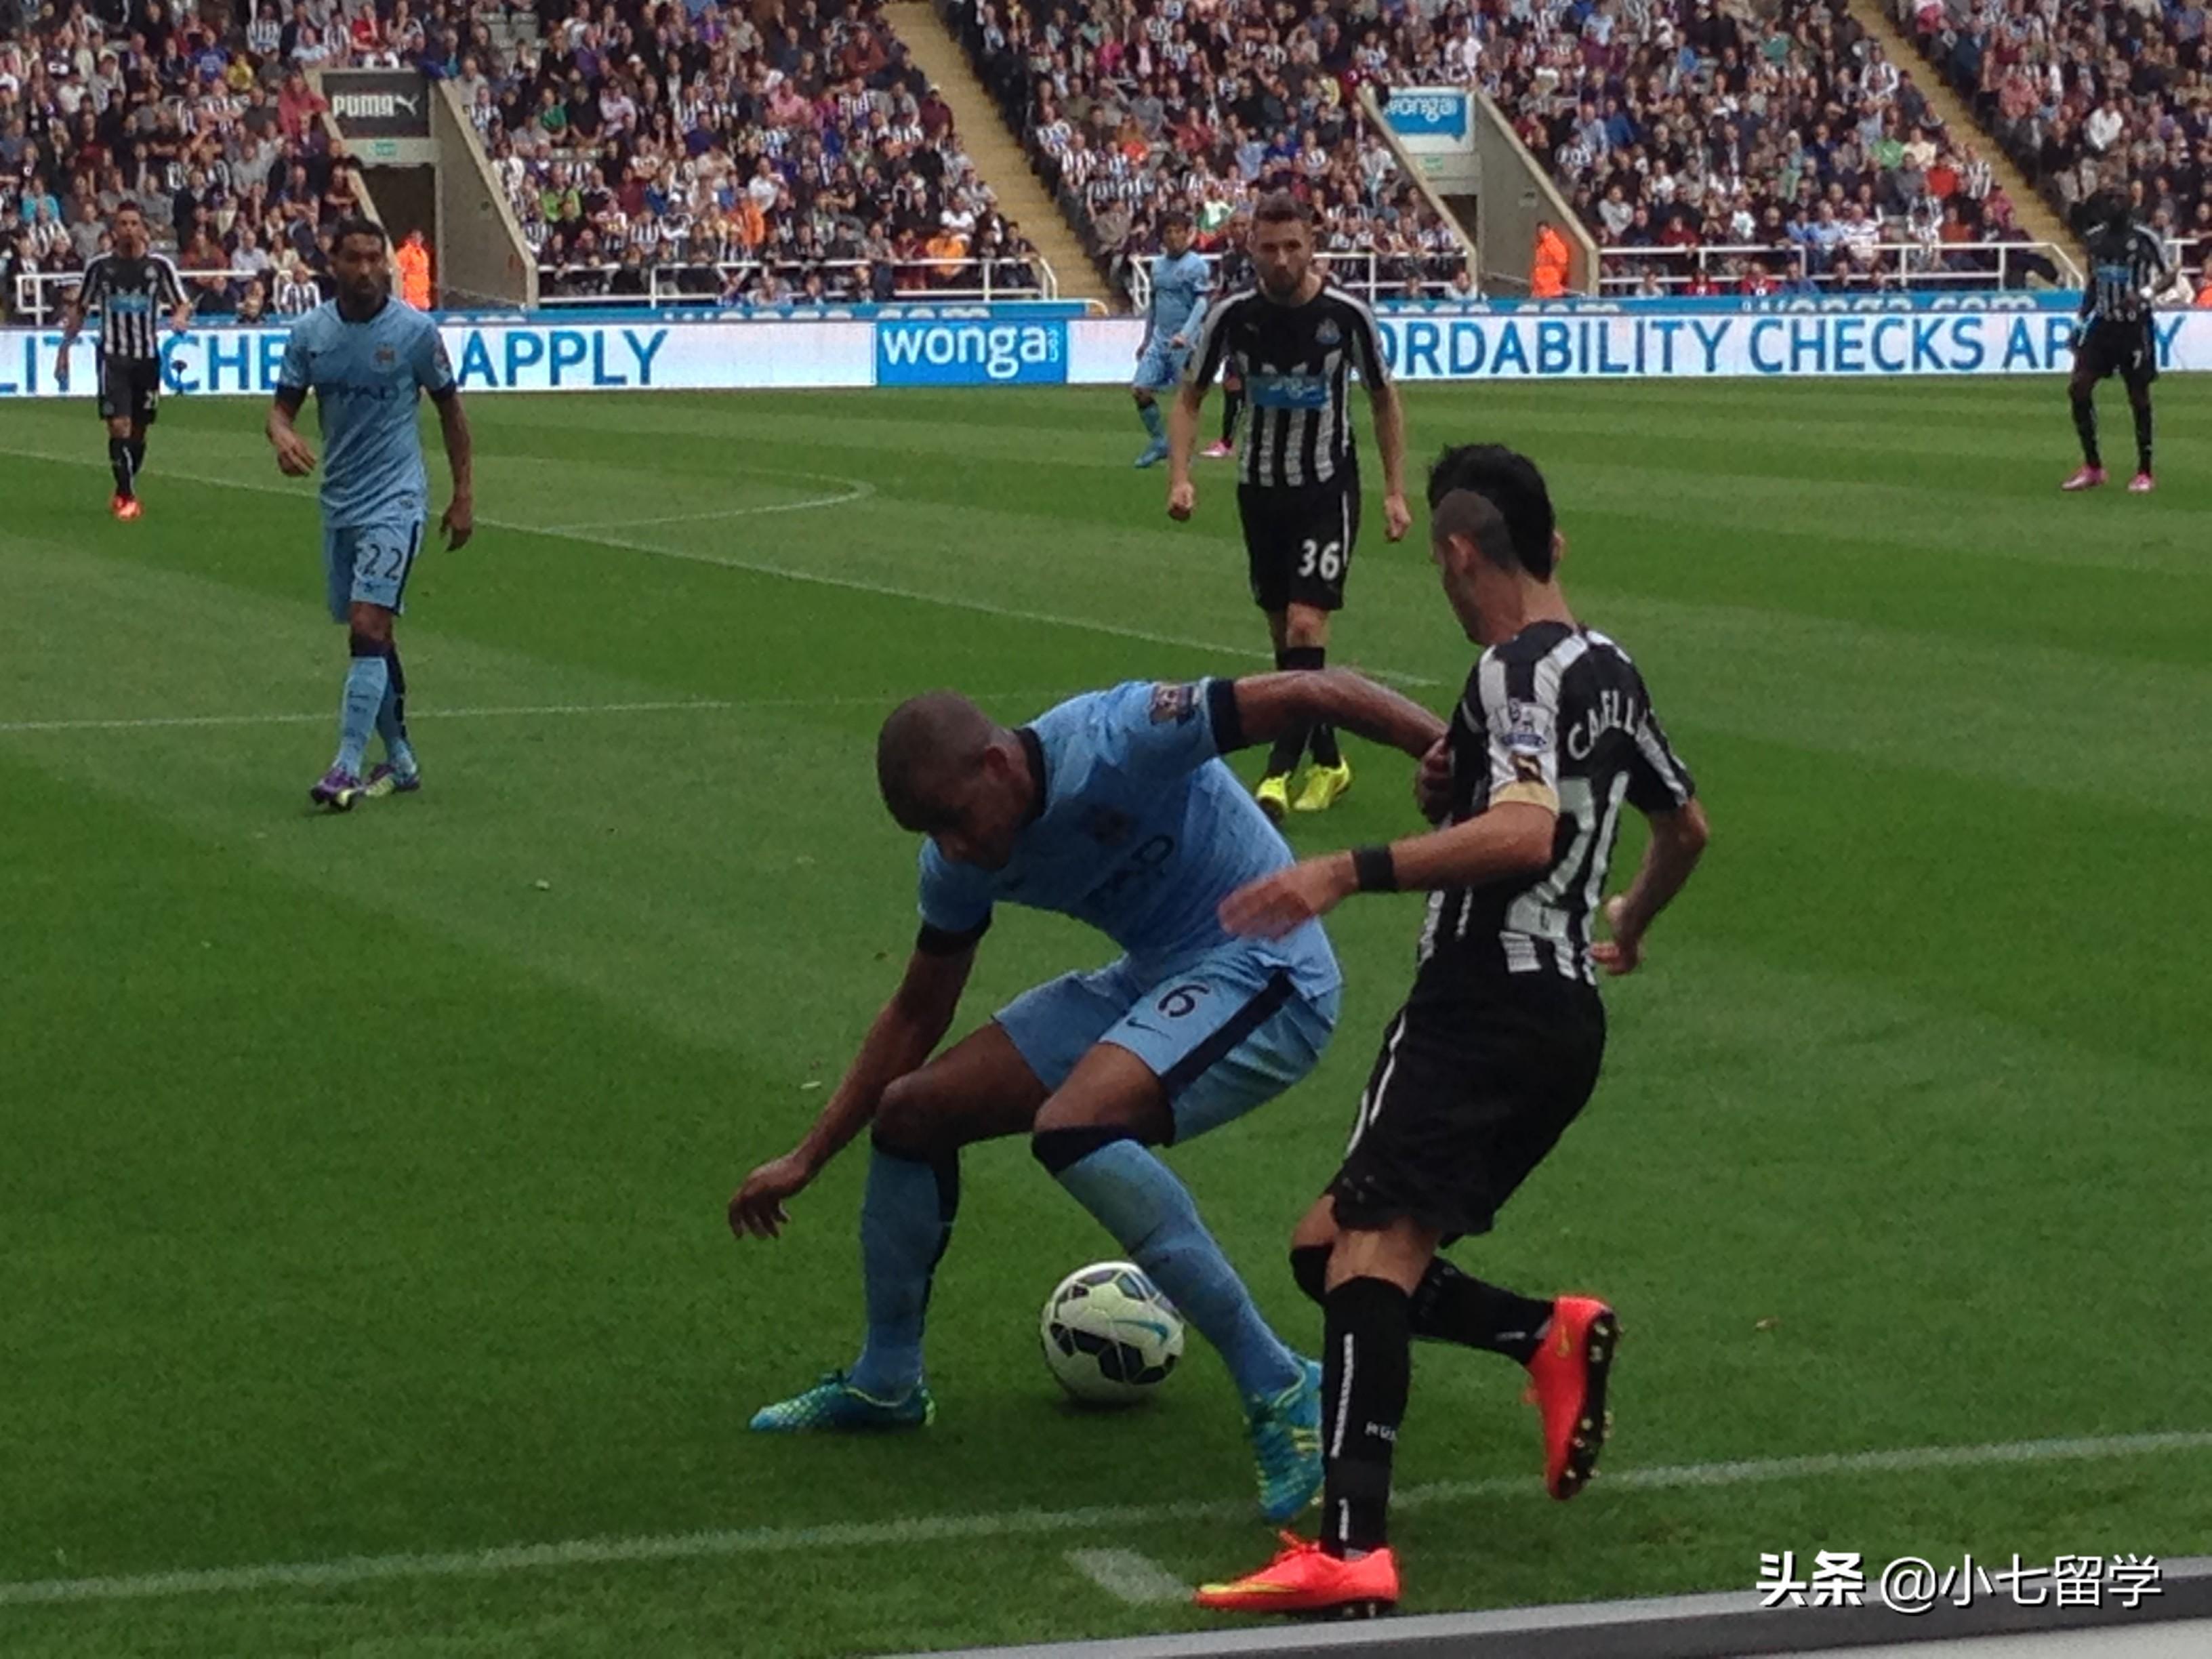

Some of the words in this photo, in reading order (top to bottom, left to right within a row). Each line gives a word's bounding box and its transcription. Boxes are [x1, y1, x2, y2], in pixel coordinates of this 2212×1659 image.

[332, 94, 394, 117] PUMA
[457, 329, 668, 386] APPLY
[882, 326, 1046, 379] wonga
[1749, 316, 1986, 373] CHECKS
[2001, 314, 2186, 370] APY
[362, 544, 404, 581] 22
[1298, 539, 1340, 581] 36
[1158, 984, 1210, 1017] 6
